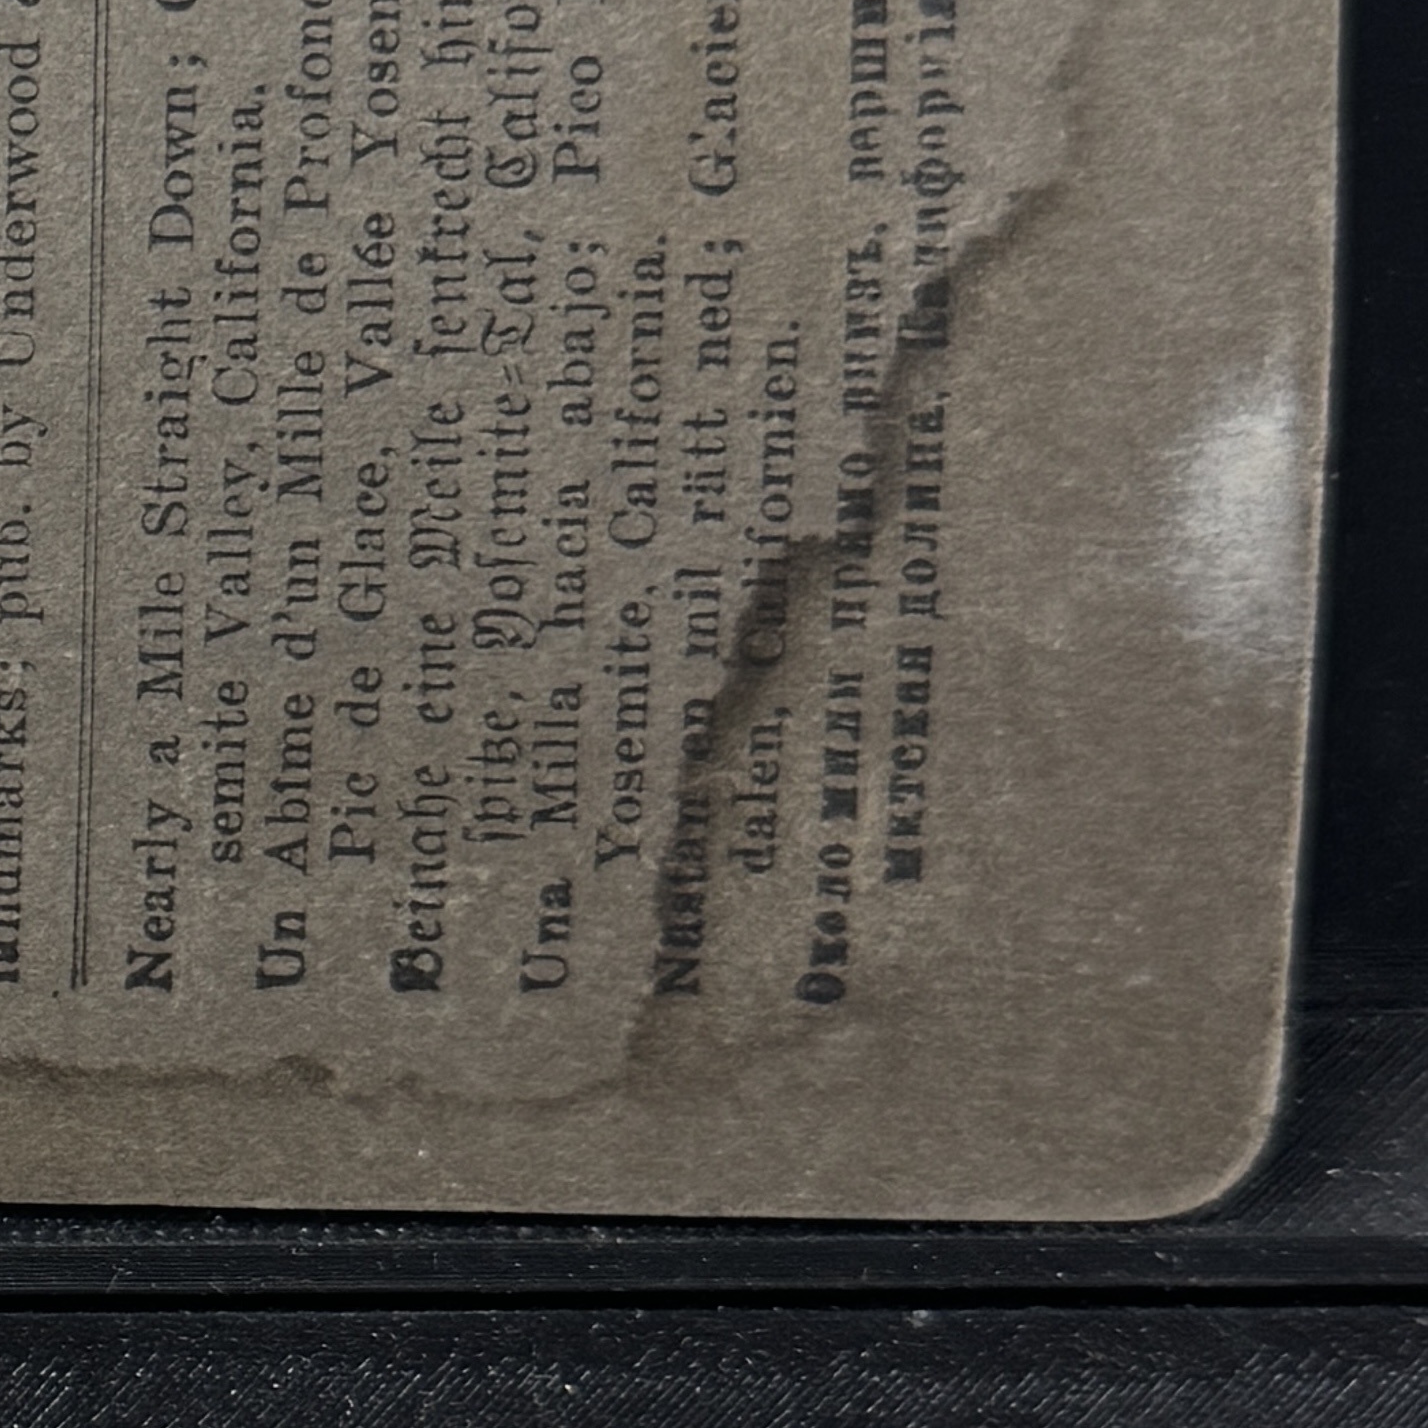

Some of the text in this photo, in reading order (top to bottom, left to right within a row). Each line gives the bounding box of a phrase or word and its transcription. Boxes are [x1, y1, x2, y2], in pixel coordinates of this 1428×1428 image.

[147, 51, 210, 252] Down;
[551, 53, 606, 184] Pico
[211, 83, 270, 407] California.
[342, 211, 398, 400] Vallée
[545, 240, 615, 427] abajo;
[140, 285, 209, 538] Straight
[607, 233, 669, 549] California.
[336, 444, 400, 623] Glace,
[537, 475, 595, 633] hacia
[134, 571, 188, 702] Mile
[333, 665, 385, 732] de
[148, 734, 182, 767] a
[194, 679, 250, 865] semite
[326, 770, 381, 865] Pic
[528, 681, 586, 831] Milla
[123, 797, 195, 995] Nearly
[517, 874, 575, 995] Una
